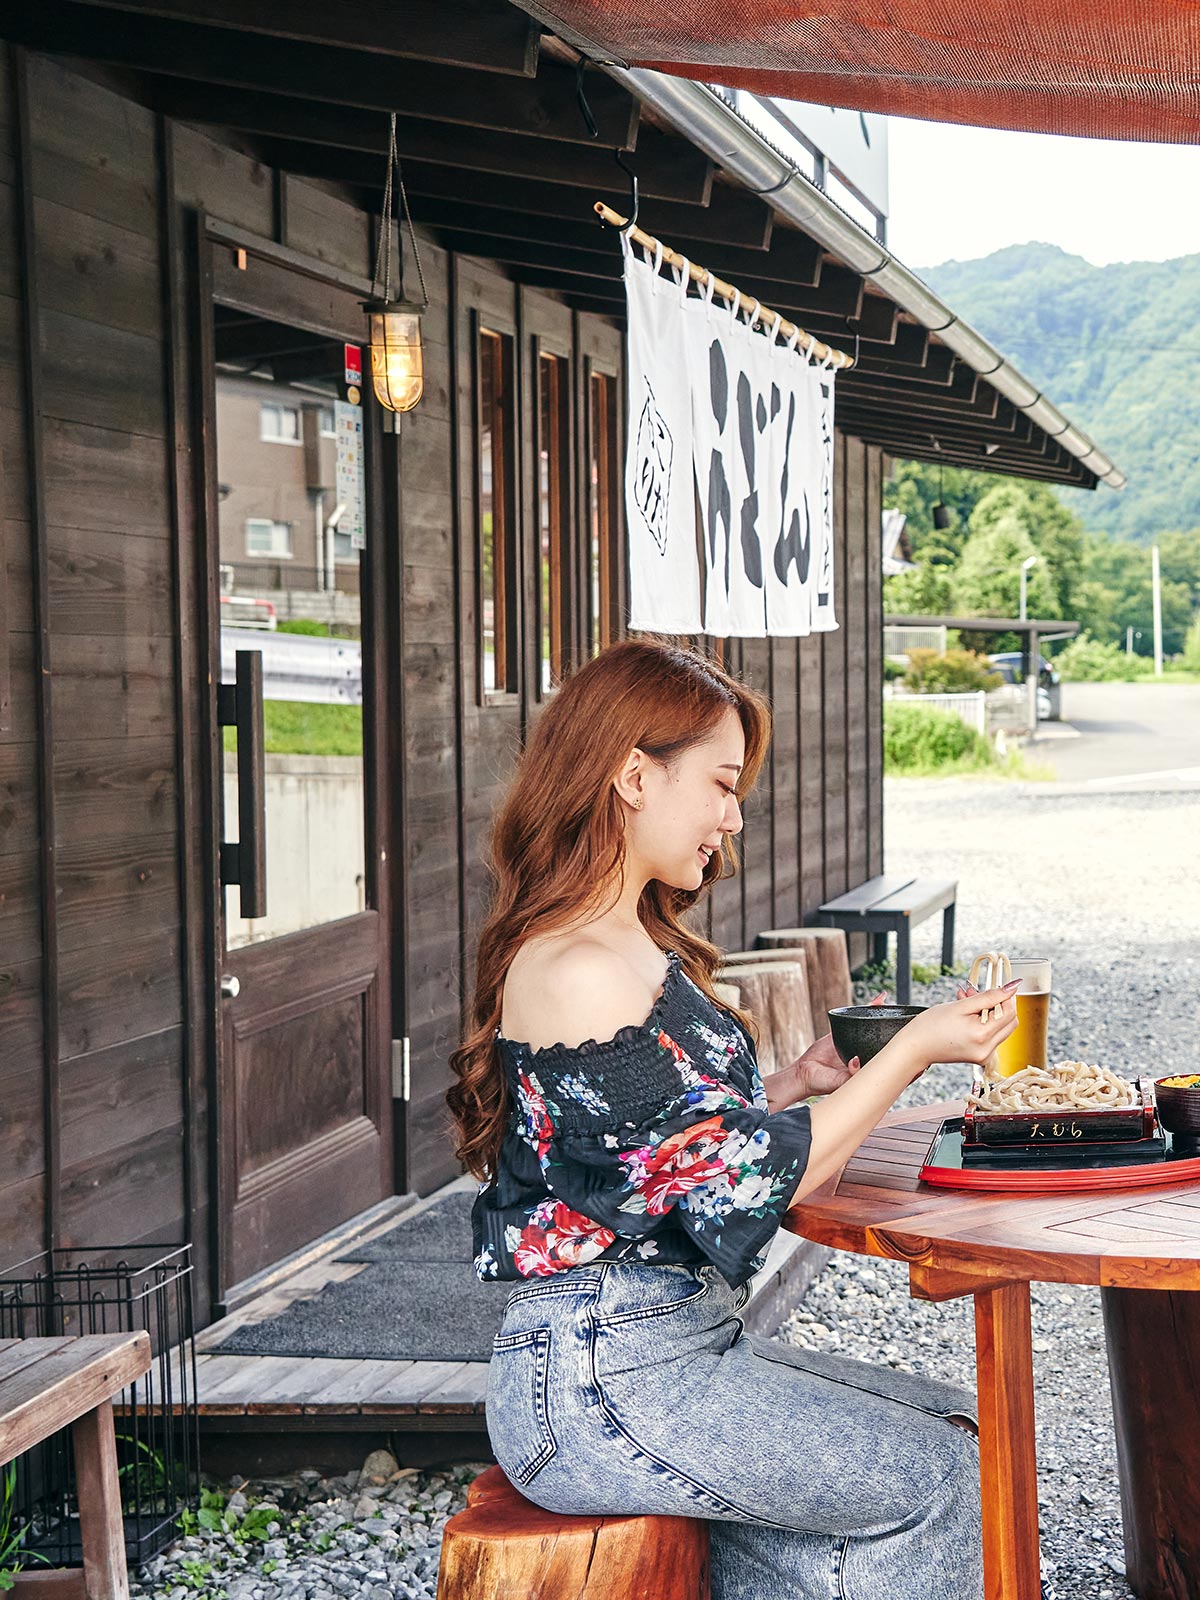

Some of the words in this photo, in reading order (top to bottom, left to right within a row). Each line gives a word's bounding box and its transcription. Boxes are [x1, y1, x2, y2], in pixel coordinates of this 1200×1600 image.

[708, 338, 811, 604] うどん
[1030, 1122, 1084, 1140] 大むら
